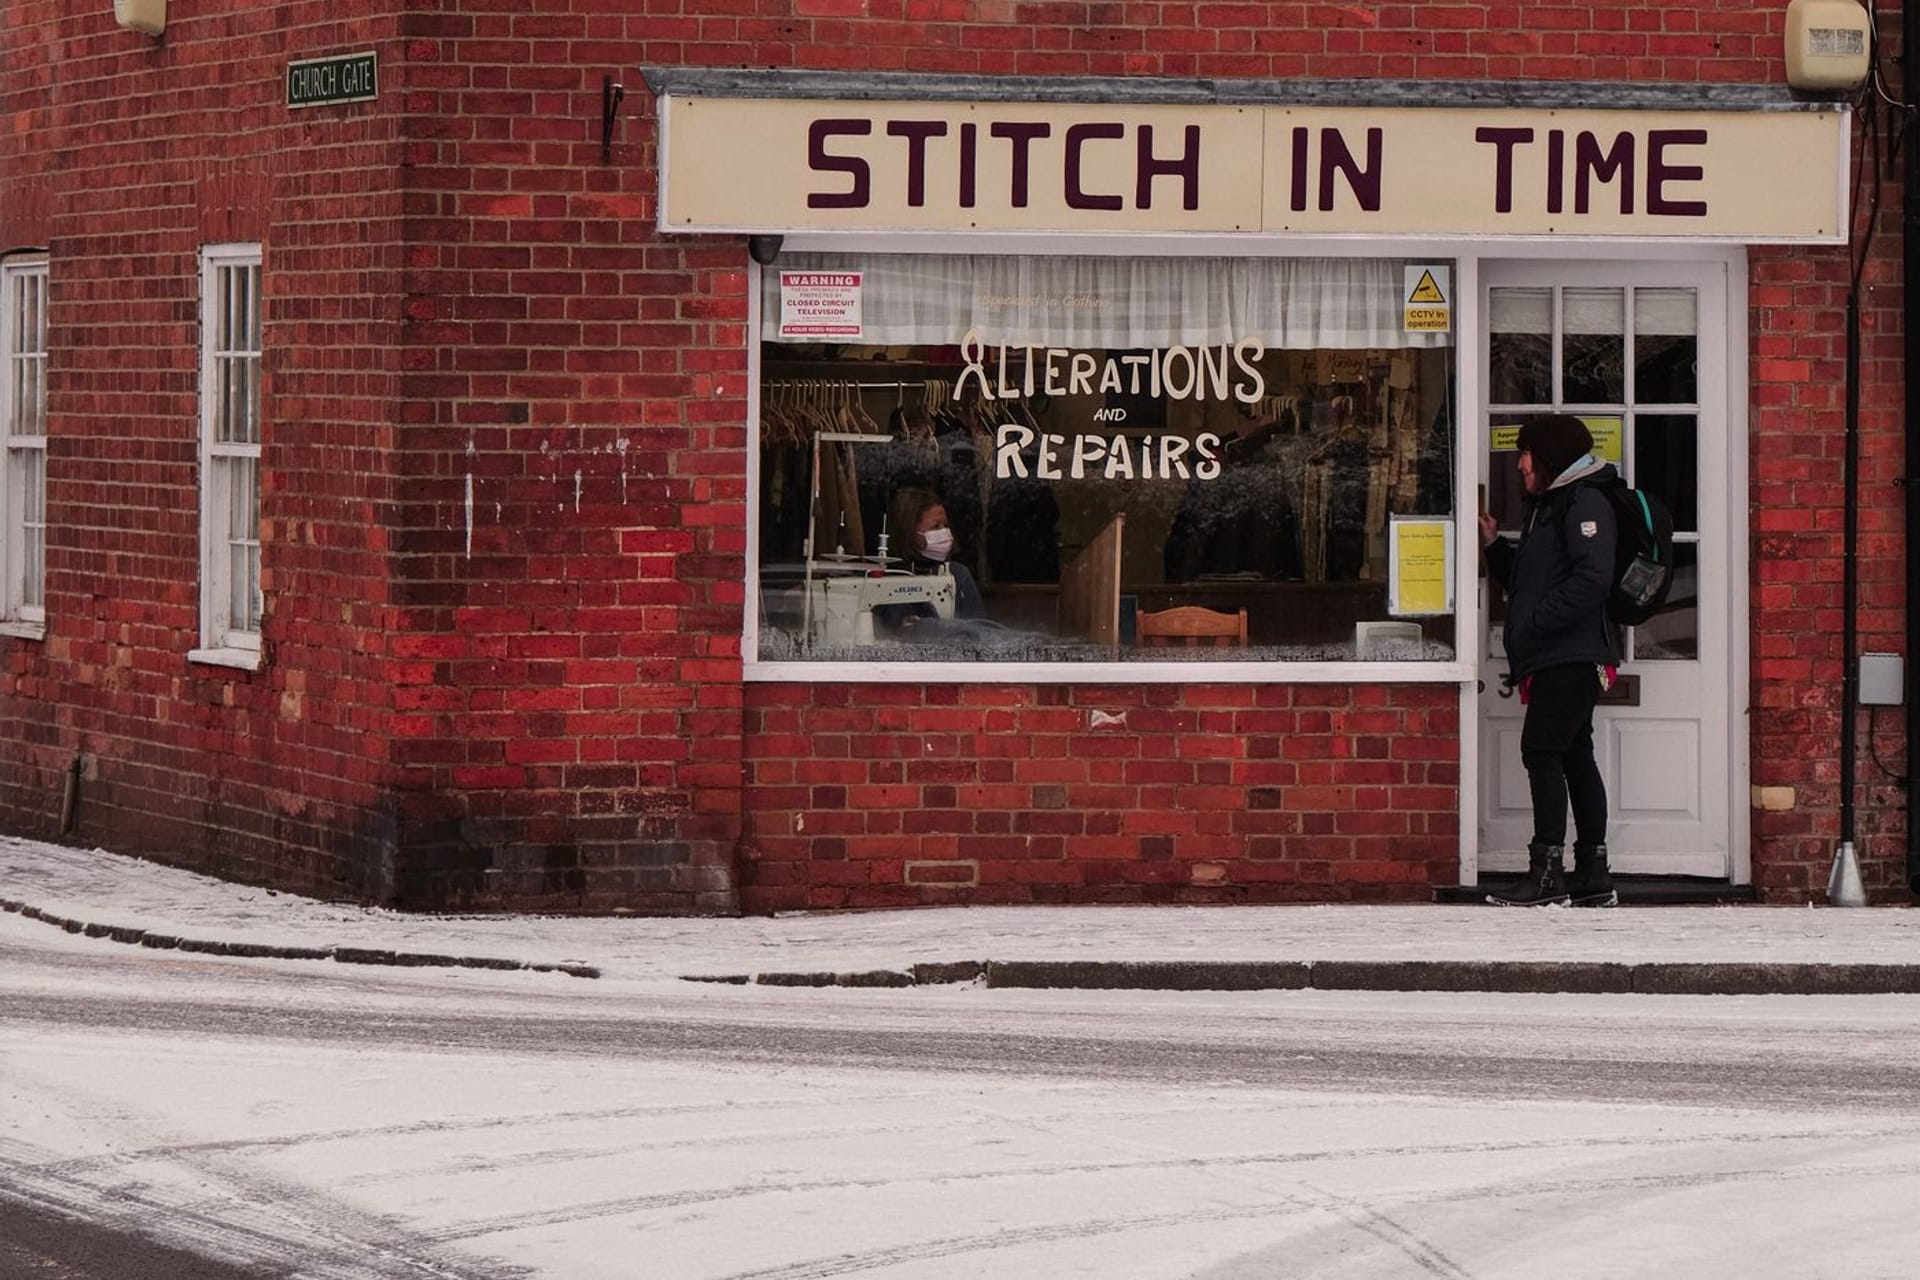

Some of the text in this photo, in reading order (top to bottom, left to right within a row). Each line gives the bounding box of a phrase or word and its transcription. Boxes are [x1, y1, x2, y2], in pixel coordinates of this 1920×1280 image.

[291, 61, 371, 99] CHURCH GATE
[807, 118, 1708, 218] STITCH IN TIME
[789, 276, 854, 286] WARNING
[1407, 320, 1447, 329] operation
[1410, 310, 1434, 318] CCTV
[953, 328, 1266, 403] ALTERATIONS
[1093, 408, 1127, 422] AND
[997, 424, 1221, 480] REPAIRS
[1498, 673, 1514, 699] 3
